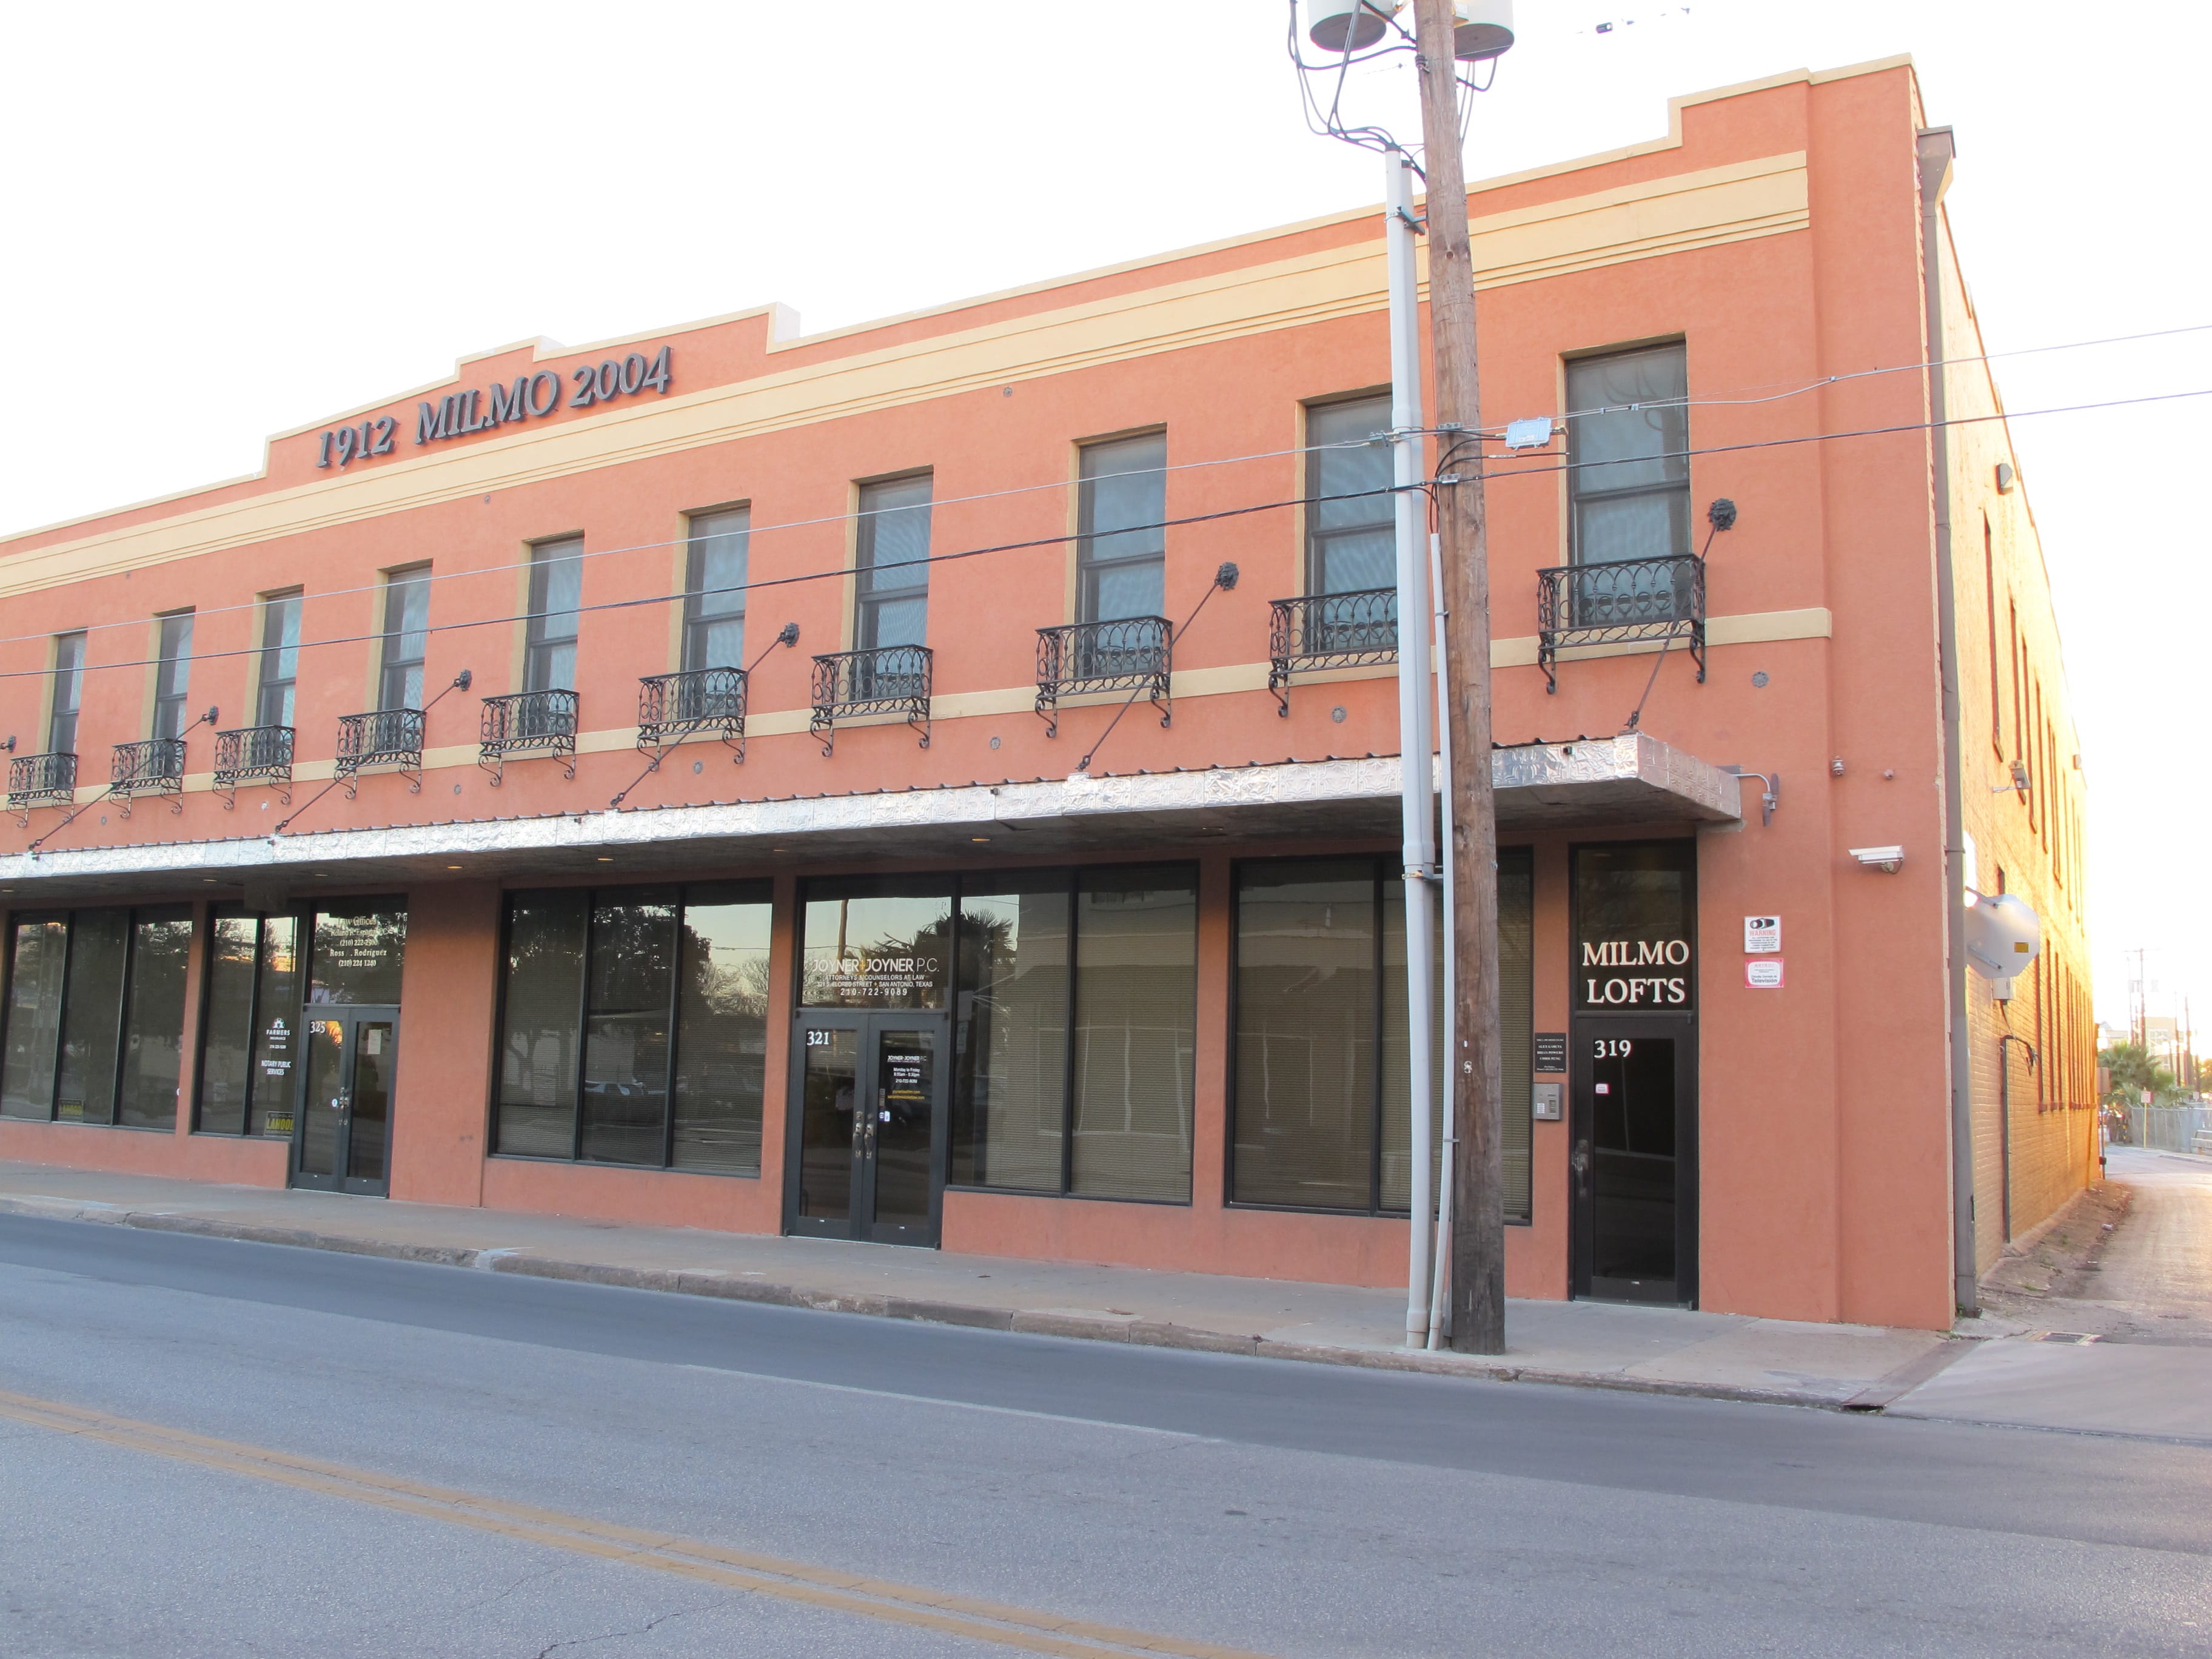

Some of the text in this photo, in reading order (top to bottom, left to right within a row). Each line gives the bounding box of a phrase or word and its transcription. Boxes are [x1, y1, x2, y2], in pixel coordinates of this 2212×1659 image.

[315, 345, 671, 468] 1912 MILMO 2004
[1582, 940, 1689, 965] MILMO
[813, 957, 939, 972] JOYNER JOYNER P.C.
[1587, 978, 1685, 1004] LOFTS
[310, 1021, 326, 1033] 325
[806, 1031, 830, 1046] 321
[1594, 1039, 1631, 1058] 319
